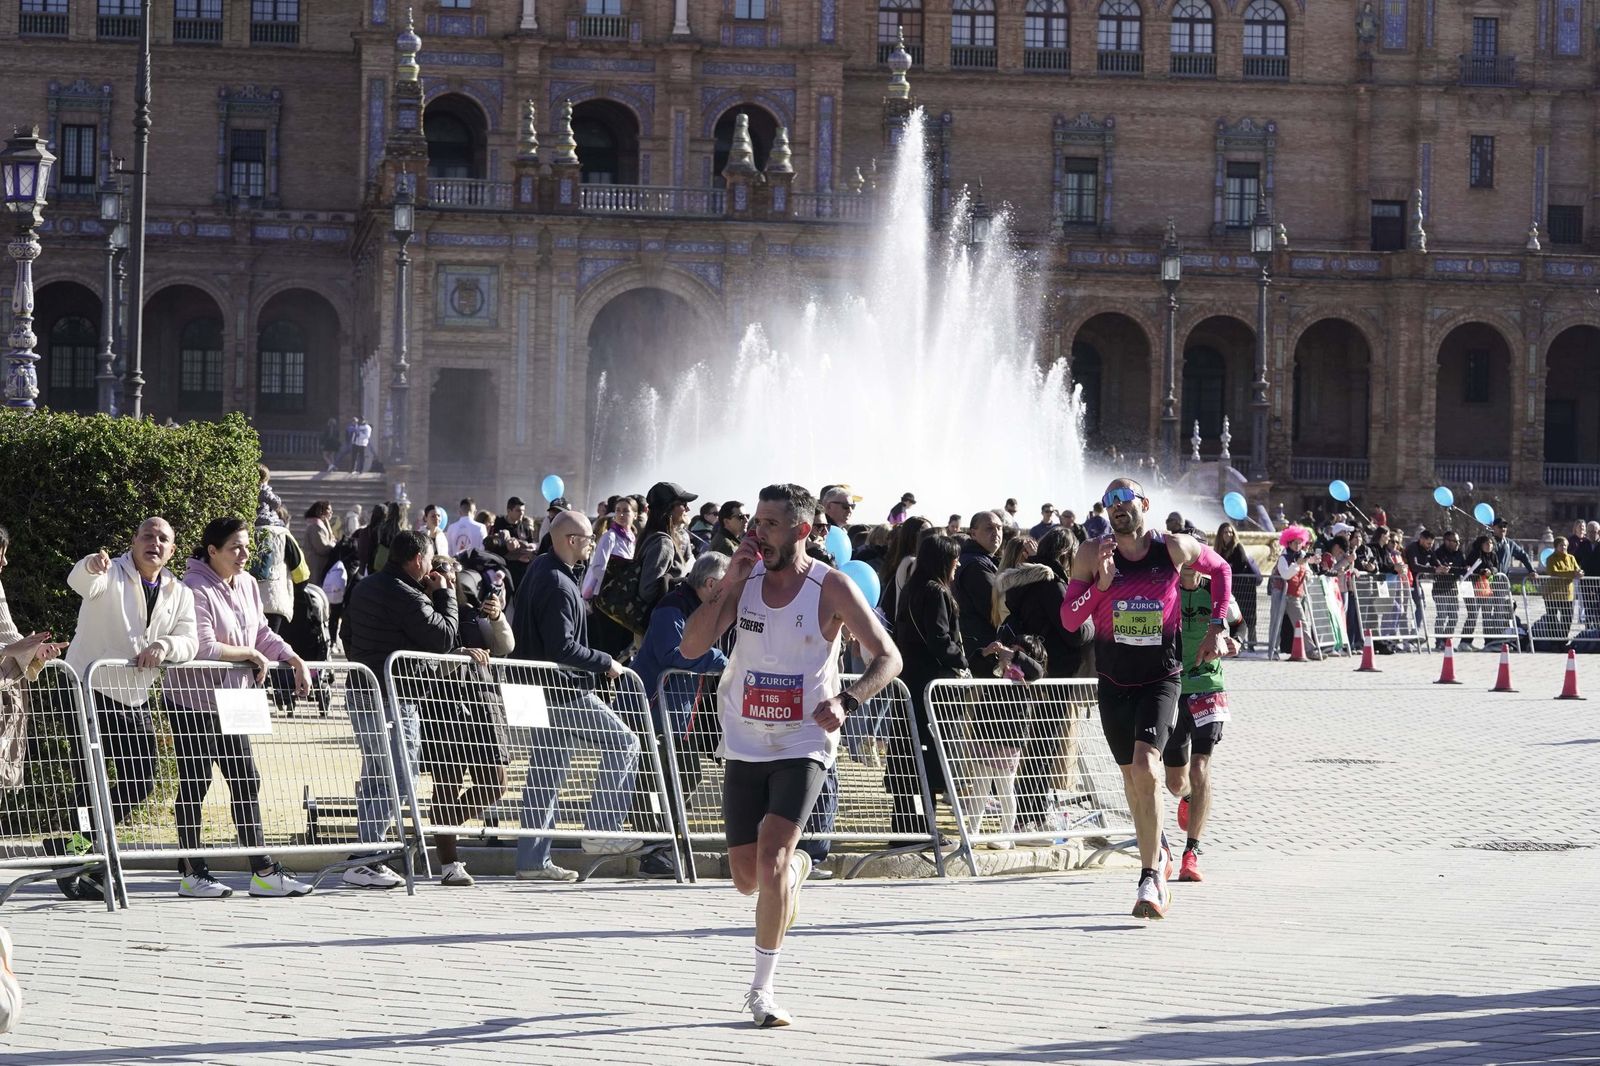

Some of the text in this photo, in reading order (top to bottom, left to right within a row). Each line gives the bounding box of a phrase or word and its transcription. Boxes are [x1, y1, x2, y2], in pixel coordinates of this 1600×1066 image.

[739, 617, 765, 634] 226ERS
[1114, 624, 1162, 635] AGUS-ÁLEX
[760, 676, 796, 686] ZURICH
[760, 694, 780, 704] 1165
[749, 704, 792, 719] MARCO
